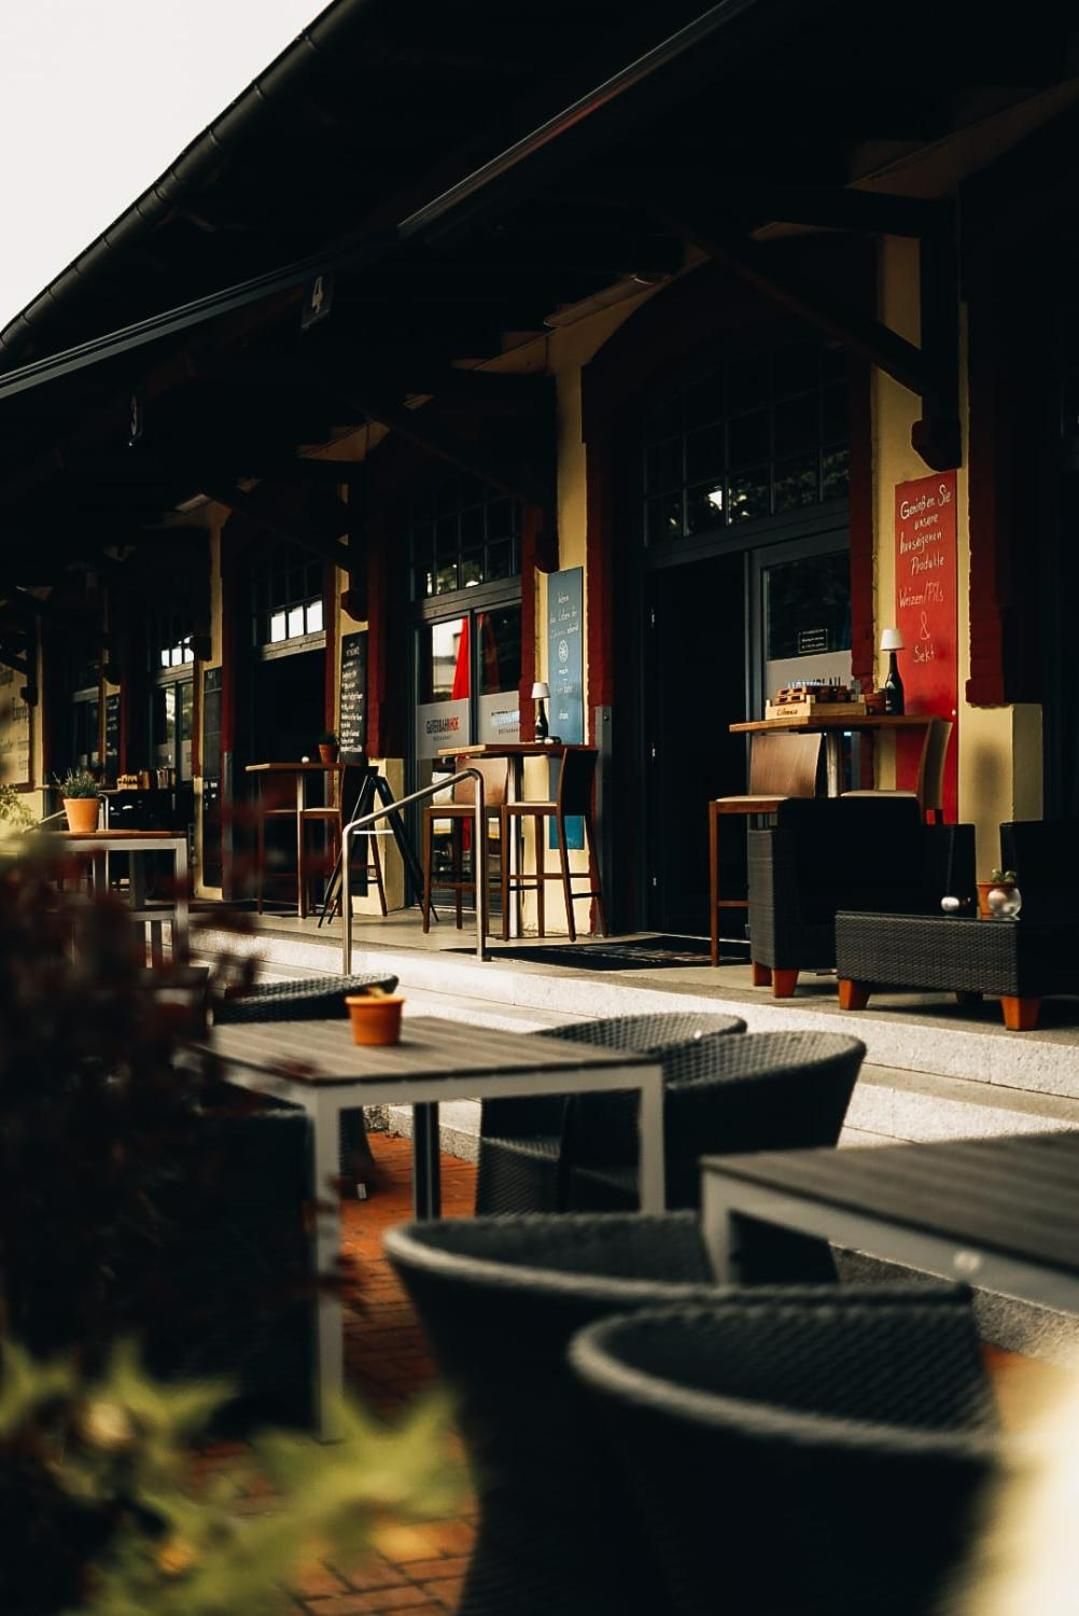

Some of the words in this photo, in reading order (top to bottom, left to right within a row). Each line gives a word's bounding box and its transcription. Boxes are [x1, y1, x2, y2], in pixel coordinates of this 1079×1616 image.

[312, 276, 323, 313] 4
[938, 484, 951, 506] Sie
[911, 553, 944, 575] Produkte
[920, 611, 931, 640] &
[913, 644, 934, 662] Sekt
